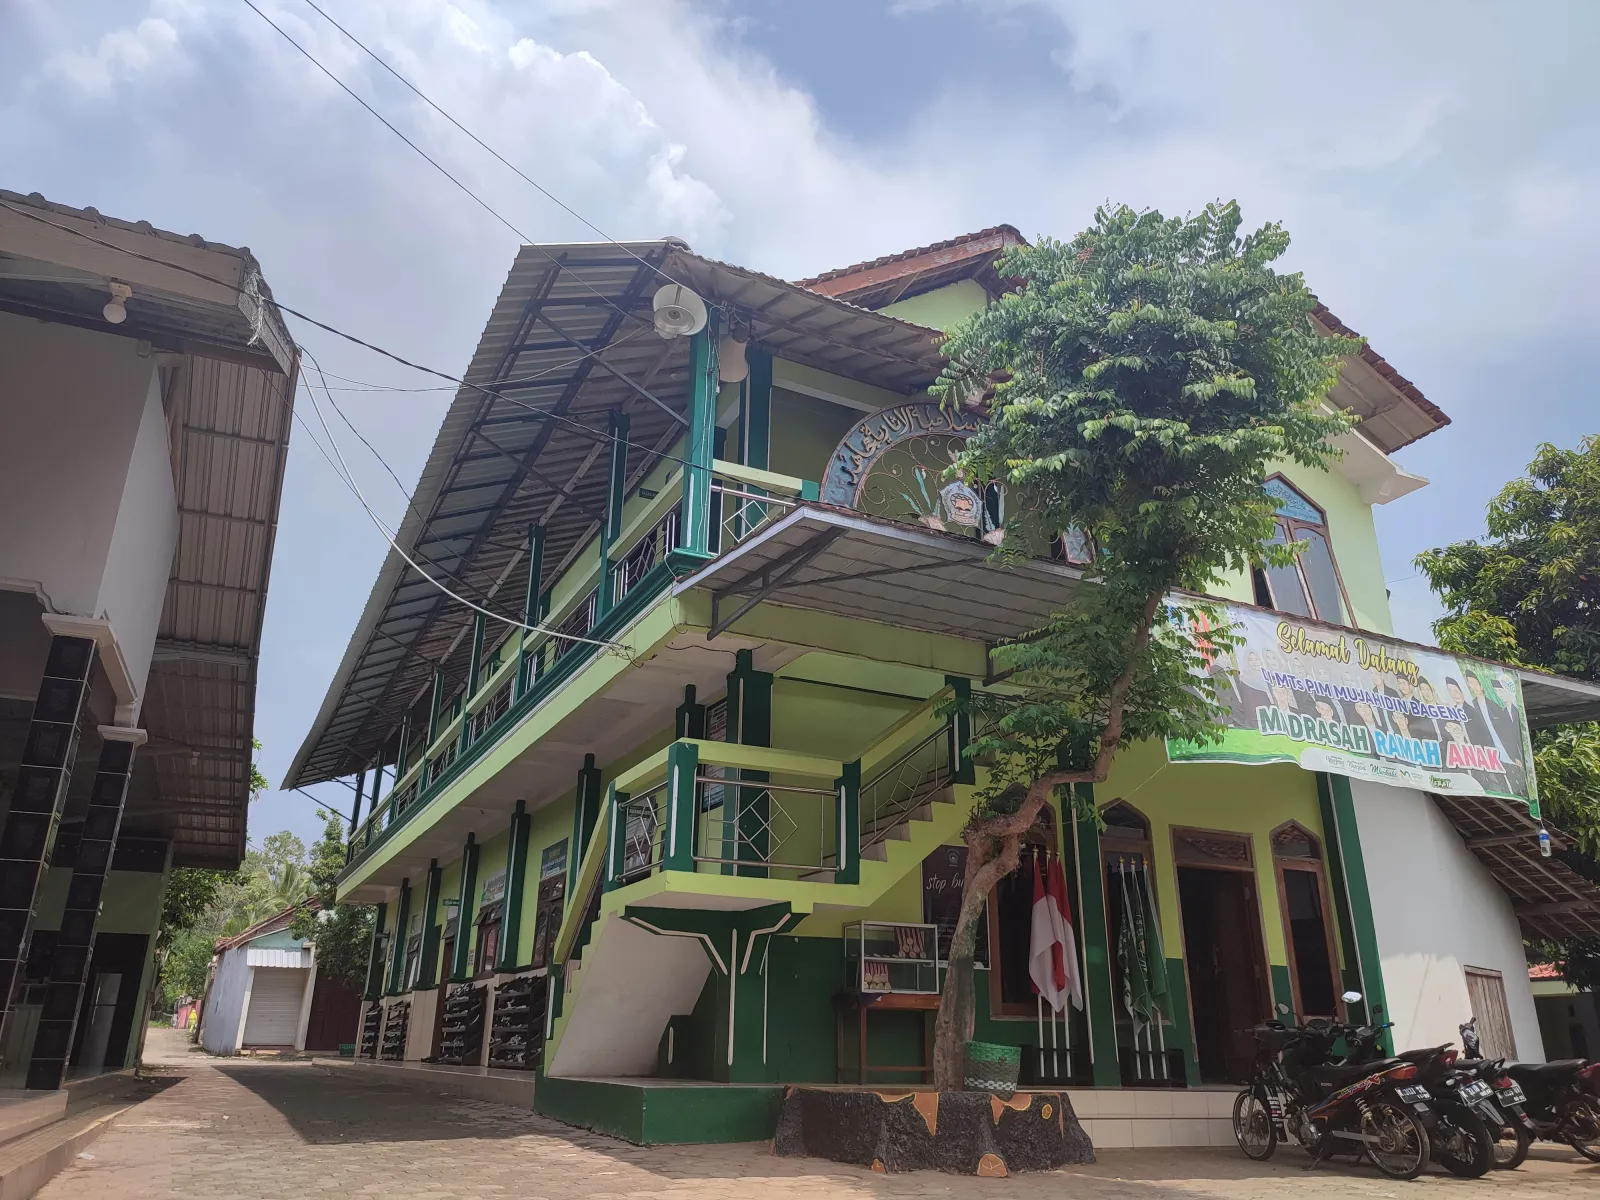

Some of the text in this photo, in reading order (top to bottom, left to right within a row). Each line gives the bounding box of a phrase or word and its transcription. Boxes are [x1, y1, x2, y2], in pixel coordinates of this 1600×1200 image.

[1277, 621, 1420, 687] Selamat Datang
[1274, 671, 1305, 691] MTs
[1304, 678, 1333, 697] PIM
[1333, 684, 1409, 714] MUJAHIDIN
[1410, 701, 1468, 721] BAGENG
[1374, 730, 1441, 767] RAMAH
[1448, 743, 1504, 772] ANAK
[926, 872, 947, 894] stop
